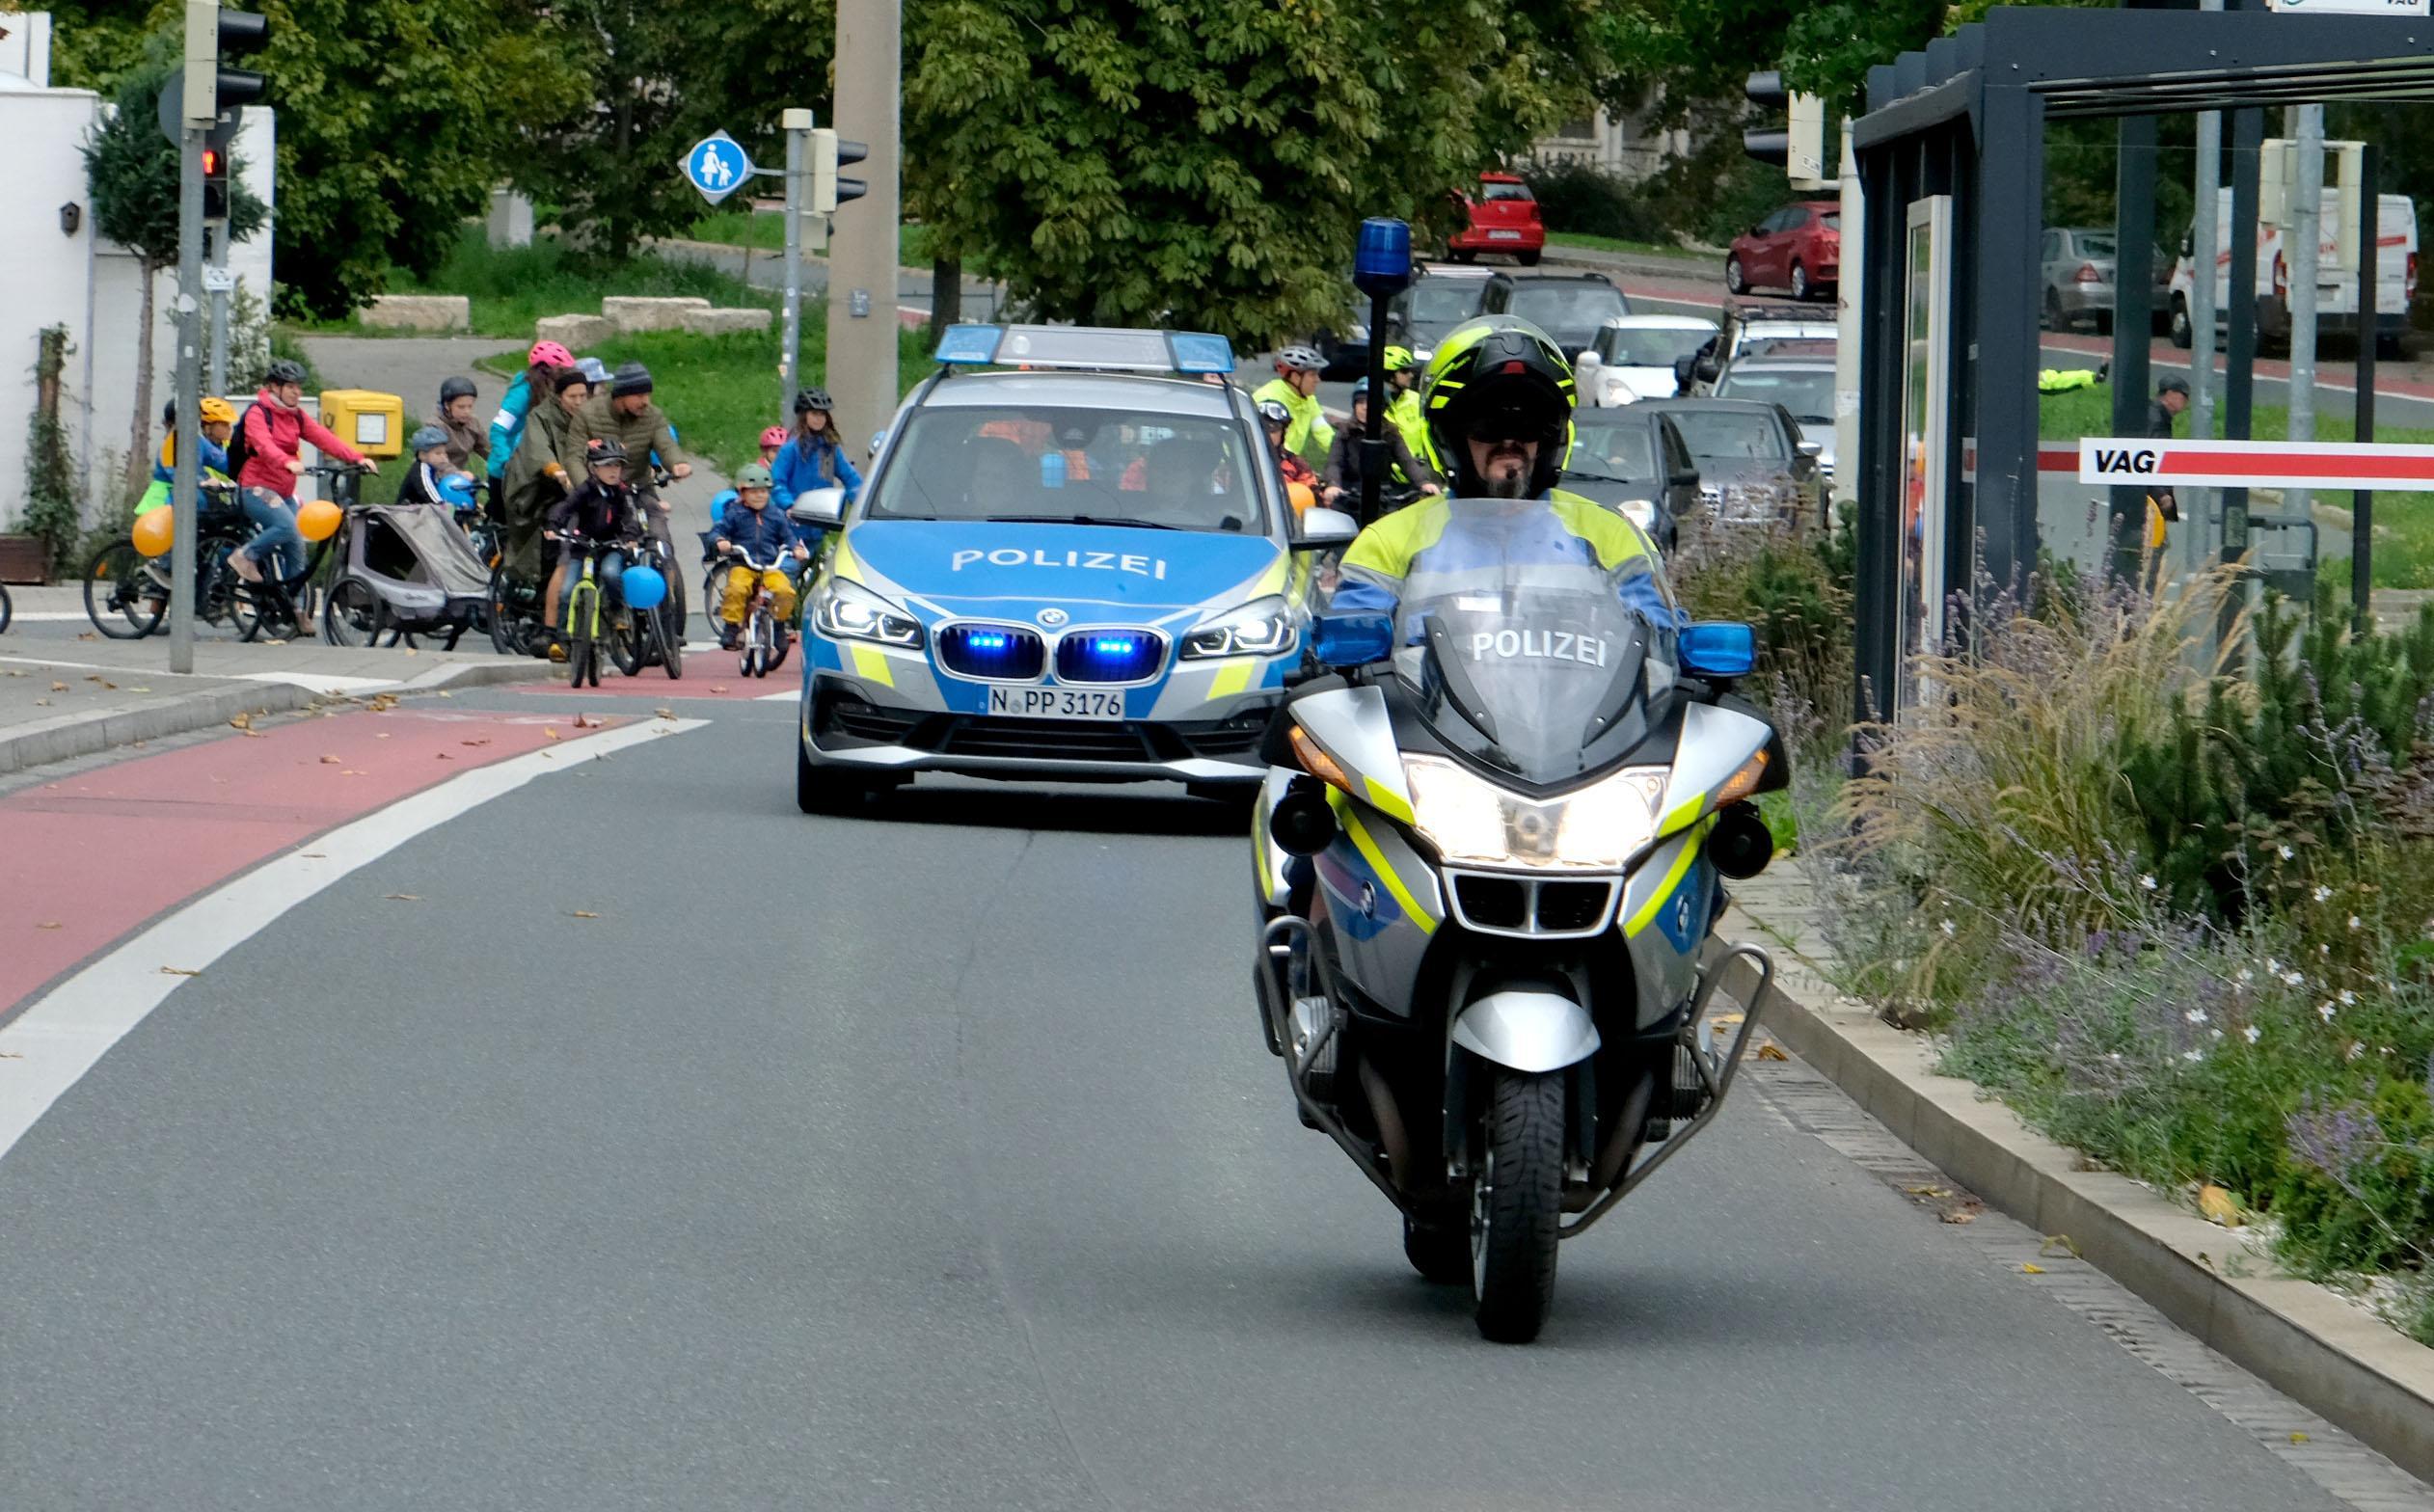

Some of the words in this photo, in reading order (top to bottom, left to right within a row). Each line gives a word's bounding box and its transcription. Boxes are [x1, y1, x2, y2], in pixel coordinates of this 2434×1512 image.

[2095, 449, 2156, 473] VAG
[952, 549, 1167, 580] POLIZEI
[1473, 629, 1607, 668] POLIZEI
[991, 688, 1008, 712] N
[1025, 690, 1055, 714] PP
[1061, 692, 1121, 716] 3176
